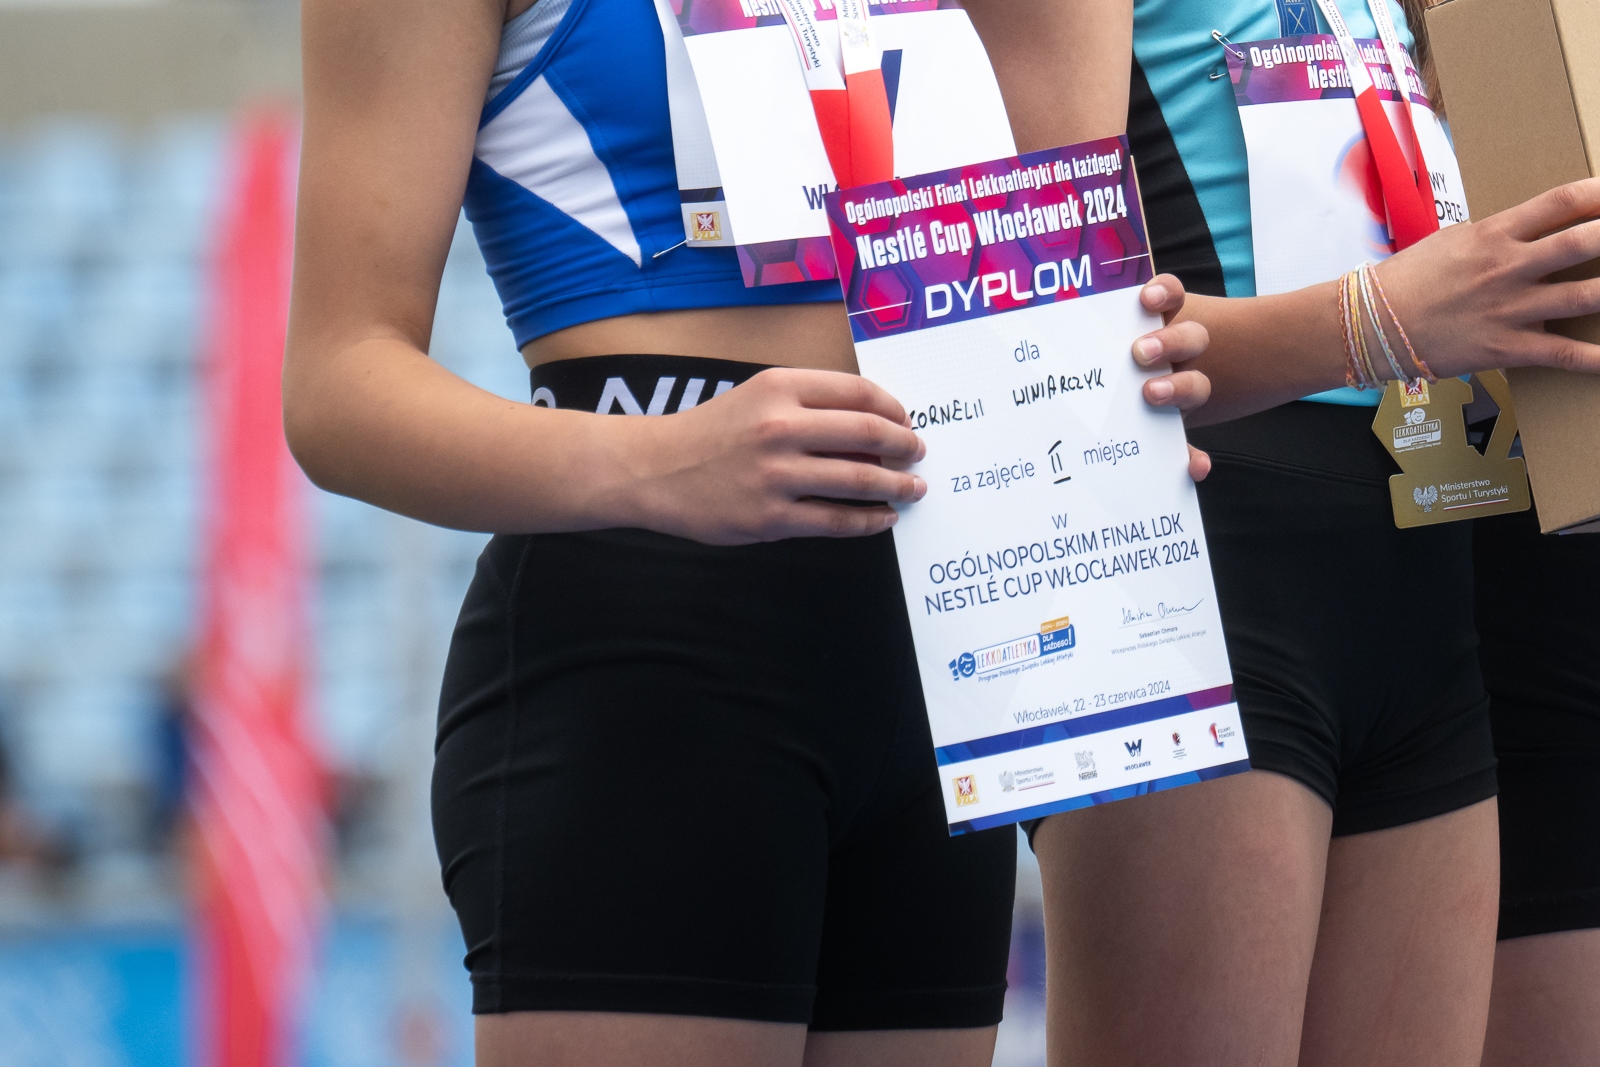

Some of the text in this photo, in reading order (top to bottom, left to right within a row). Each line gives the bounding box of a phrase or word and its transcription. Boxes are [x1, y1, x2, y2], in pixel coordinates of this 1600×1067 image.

[802, 28, 821, 68] Turystyki
[1250, 39, 1343, 69] Ogólnopolski
[845, 188, 934, 226] Ogólnopolski
[935, 179, 969, 206] Finał
[969, 164, 1053, 201] Lekkoatletyki
[1053, 160, 1071, 183] dla
[1072, 148, 1123, 180] każdego!
[856, 184, 1128, 270] Nestlé Cup Włocławek 2024
[925, 254, 1093, 319] DYPLOM
[1014, 339, 1041, 362] dla
[1012, 368, 1105, 407] WINIARCZYK
[1395, 421, 1439, 438] LEKKOATLETYKA
[951, 473, 972, 493] za
[976, 458, 1035, 490] zajęcie
[1083, 438, 1140, 466] miejsca
[1440, 479, 1490, 492] Ministerstwo
[1441, 493, 1467, 503] Sportu
[1473, 486, 1508, 498] Turystyki
[929, 513, 1184, 585] OGÓLNOPOLSKIM FINAŁ LDK
[925, 539, 1200, 615] NESTLÉ CUP WŁOCŁAWEK 2024
[977, 639, 1037, 669] LEKKOATLETYKA
[1013, 680, 1171, 724] Włocławek, 22 23 czerwca 2024
